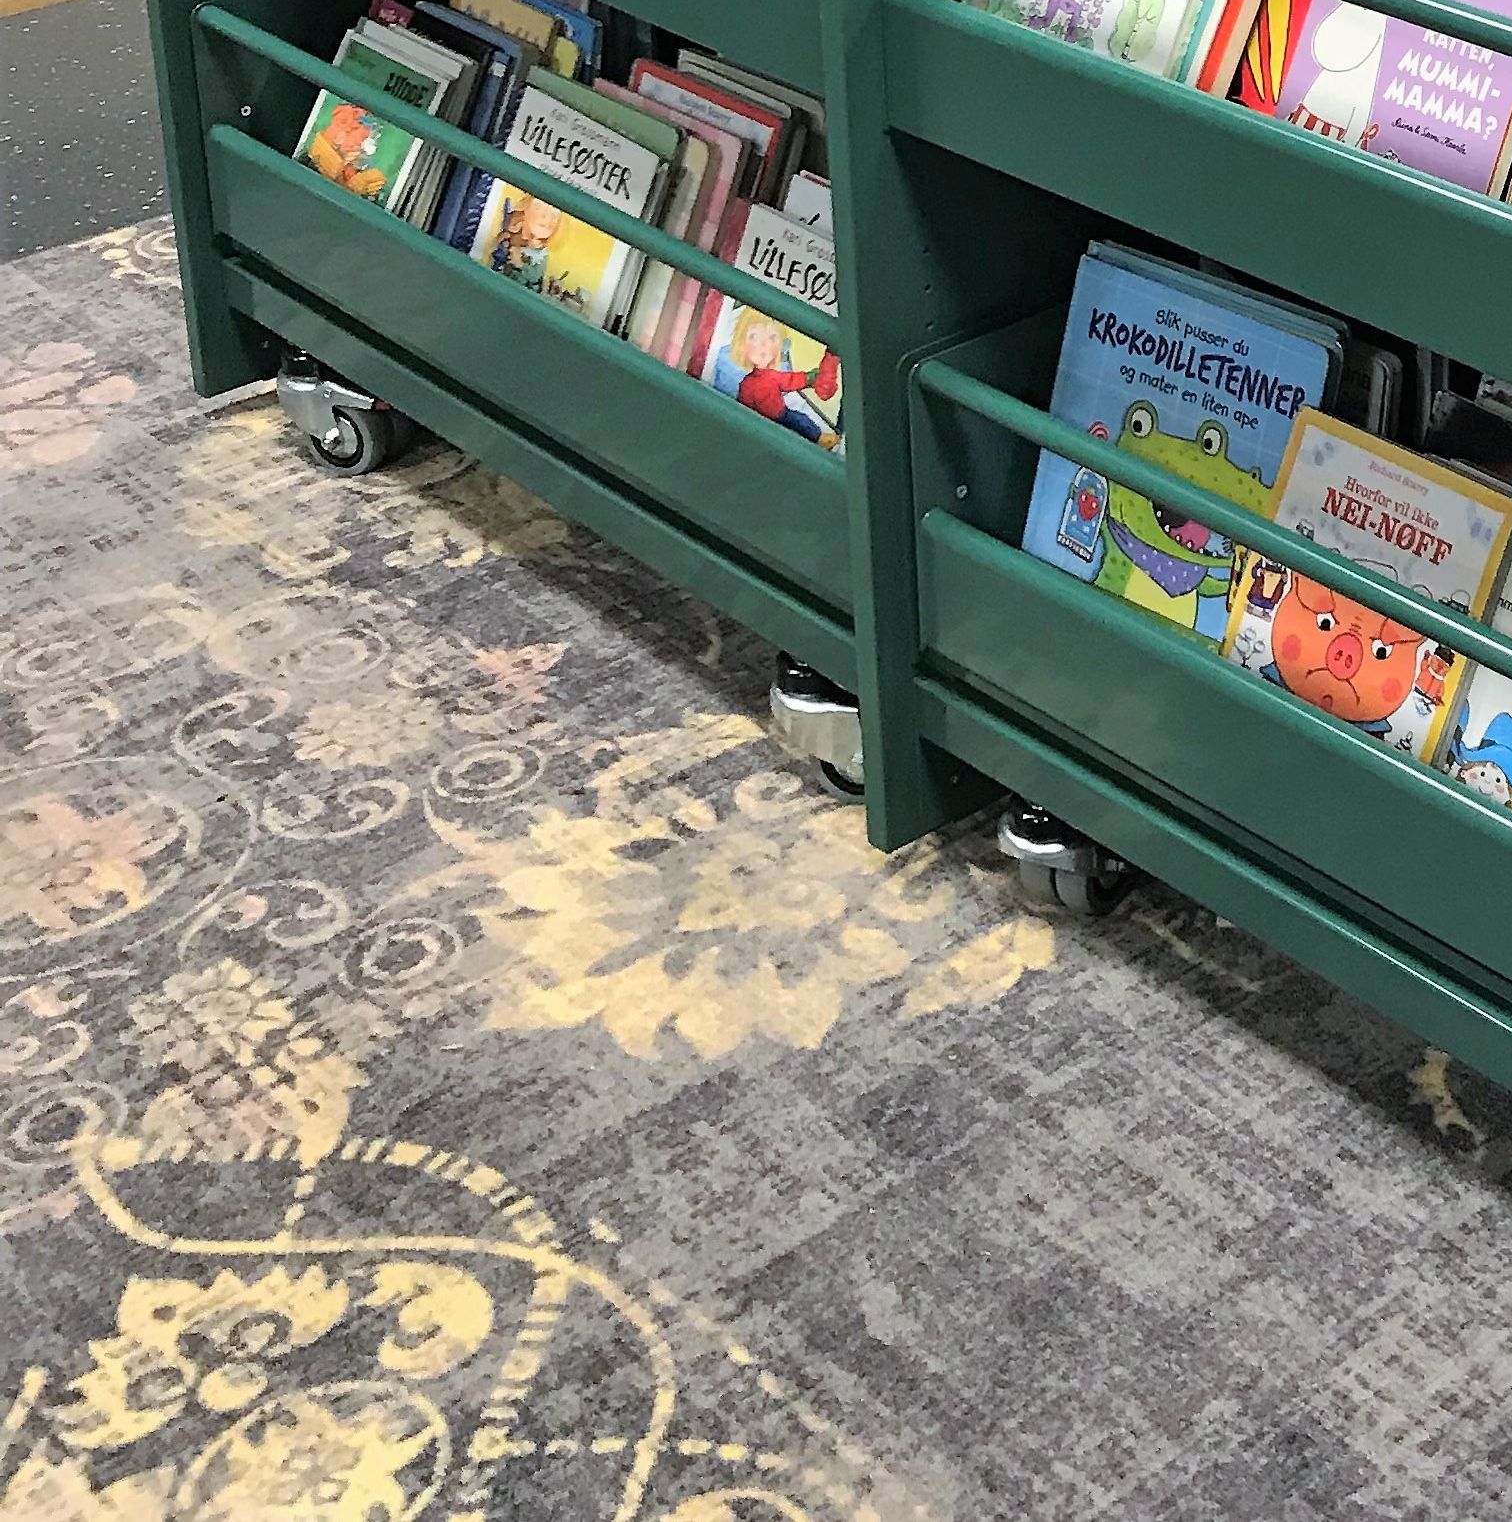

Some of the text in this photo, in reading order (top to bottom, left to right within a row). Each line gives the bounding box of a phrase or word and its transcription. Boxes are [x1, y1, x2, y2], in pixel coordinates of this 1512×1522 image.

[1397, 48, 1501, 102] MUMMI-
[1383, 77, 1498, 141] MAMMA?
[1088, 307, 1306, 420] KROKODILLETENNER
[1156, 308, 1250, 357] Slik pusser du
[1119, 365, 1260, 430] og mater en liten ape
[1321, 486, 1453, 566] NEI-NØFF
[1344, 476, 1440, 530] Hvorfor vil ikke
